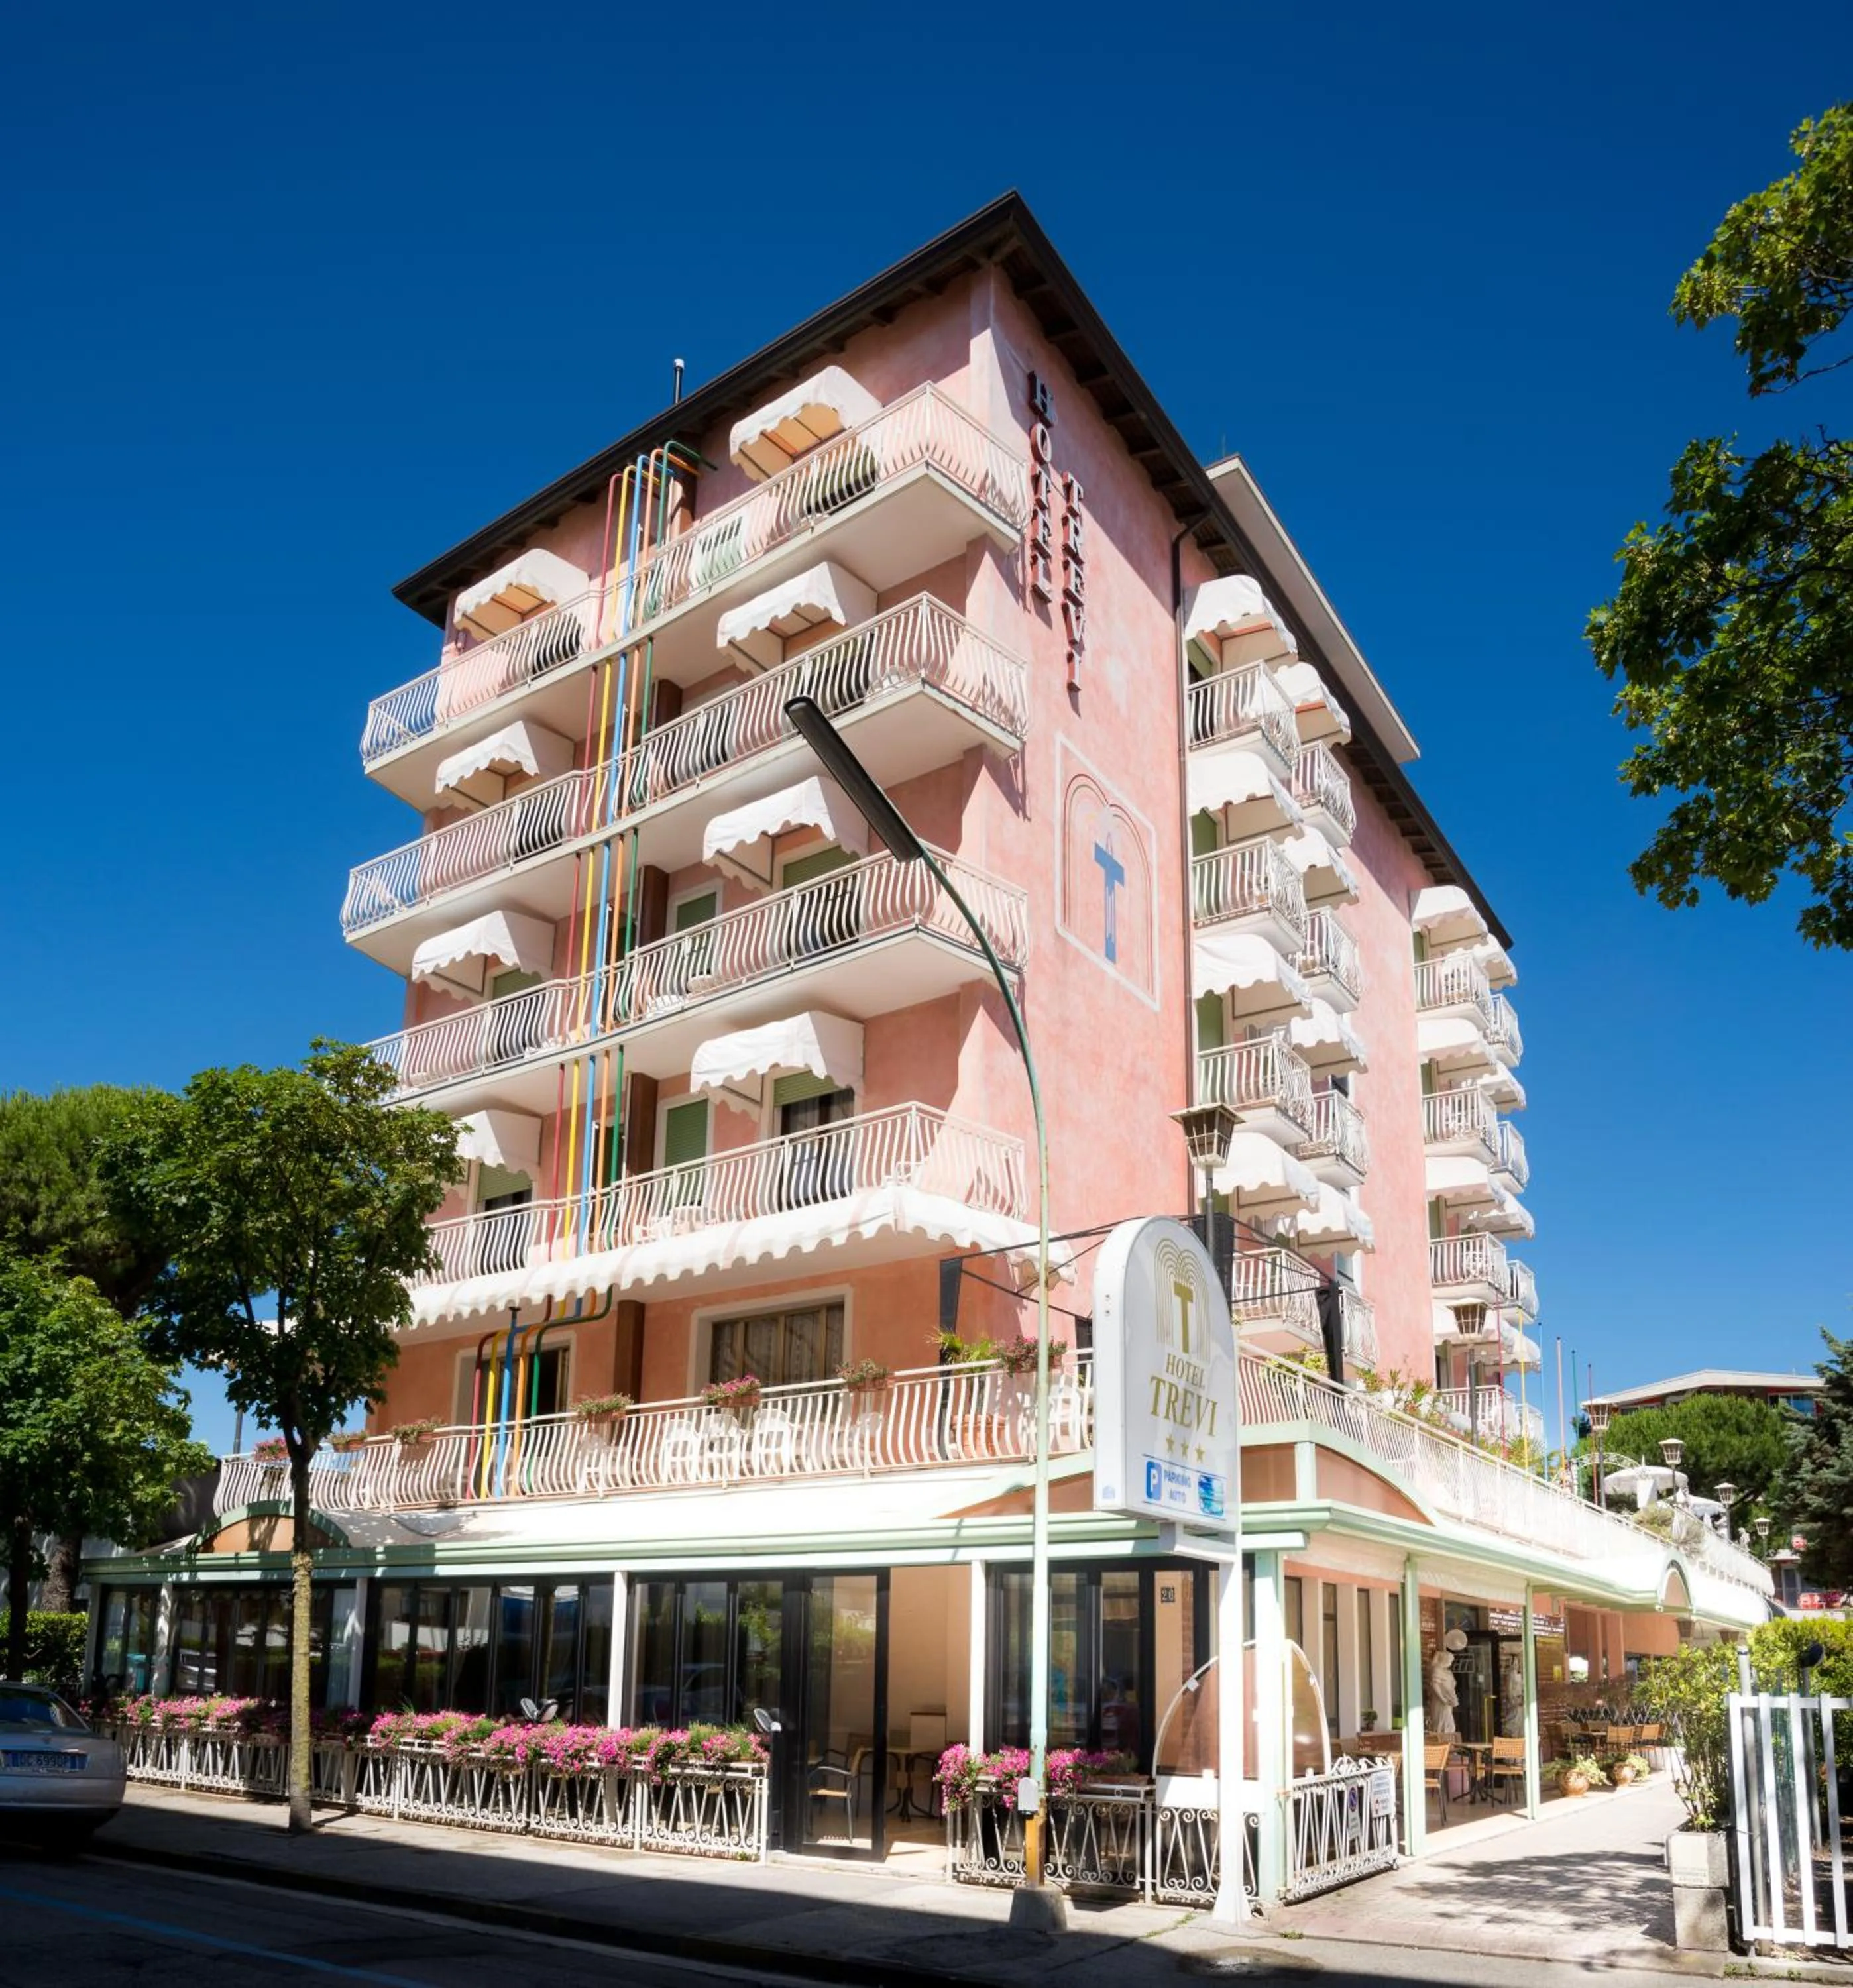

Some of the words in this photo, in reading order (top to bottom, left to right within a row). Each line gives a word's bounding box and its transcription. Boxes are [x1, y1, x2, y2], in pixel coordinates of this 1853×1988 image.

[1029, 370, 1056, 603] HOTEL
[1062, 472, 1084, 691] TREVI
[1166, 1353, 1205, 1390] HOTEL
[1151, 1376, 1218, 1437] TREVI
[1164, 1470, 1191, 1488] PARKING
[1168, 1488, 1187, 1504] AUTO
